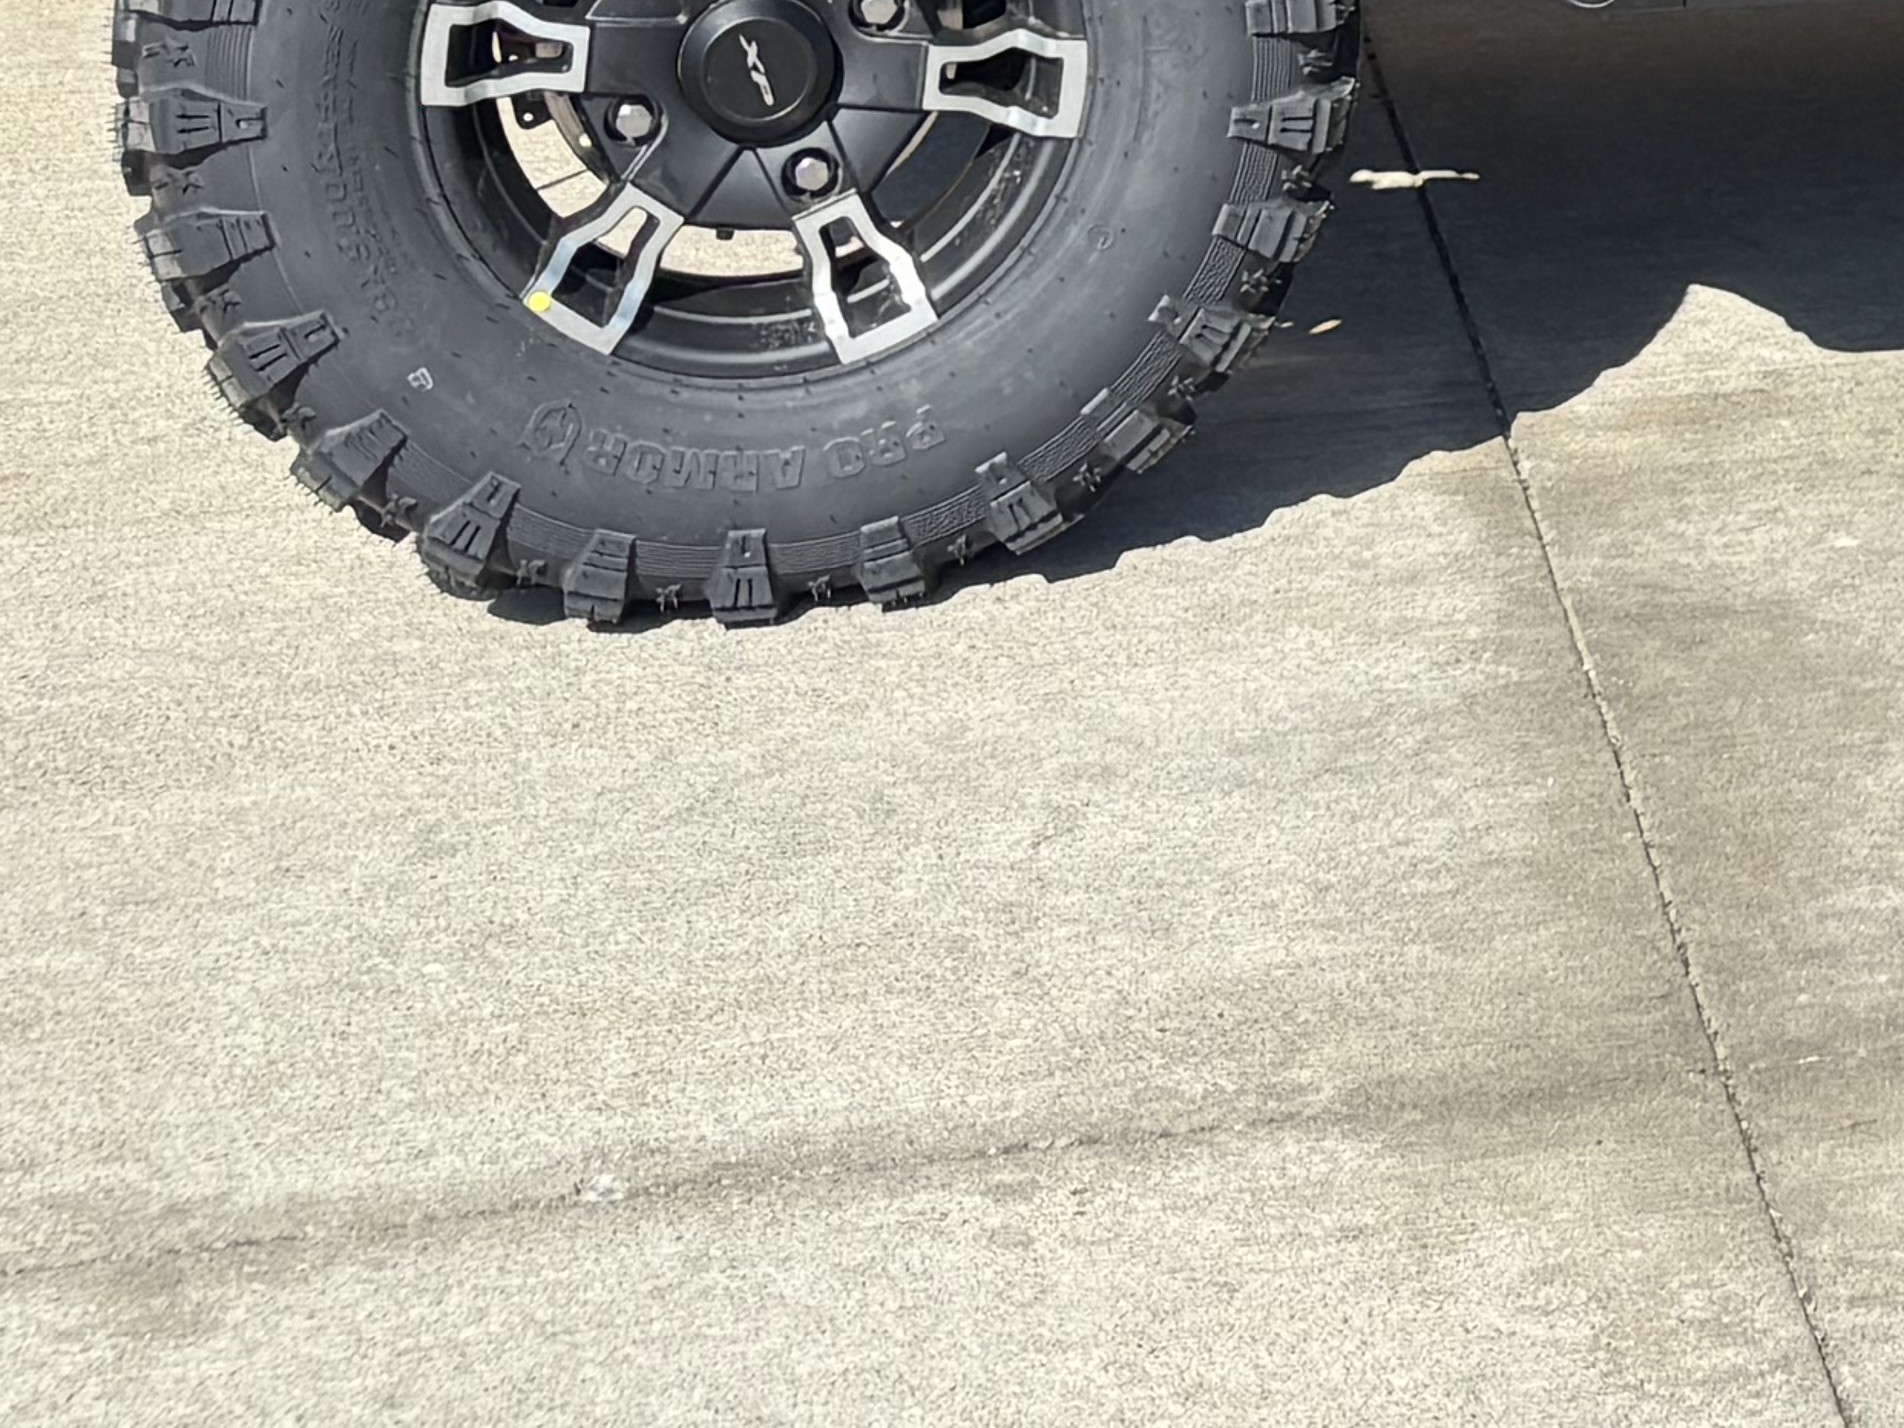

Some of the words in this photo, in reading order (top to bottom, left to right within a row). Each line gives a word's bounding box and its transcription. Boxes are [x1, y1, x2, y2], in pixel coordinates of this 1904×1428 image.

[738, 33, 776, 107] XP
[585, 428, 805, 492] ARMOR
[822, 403, 945, 479] PRO
